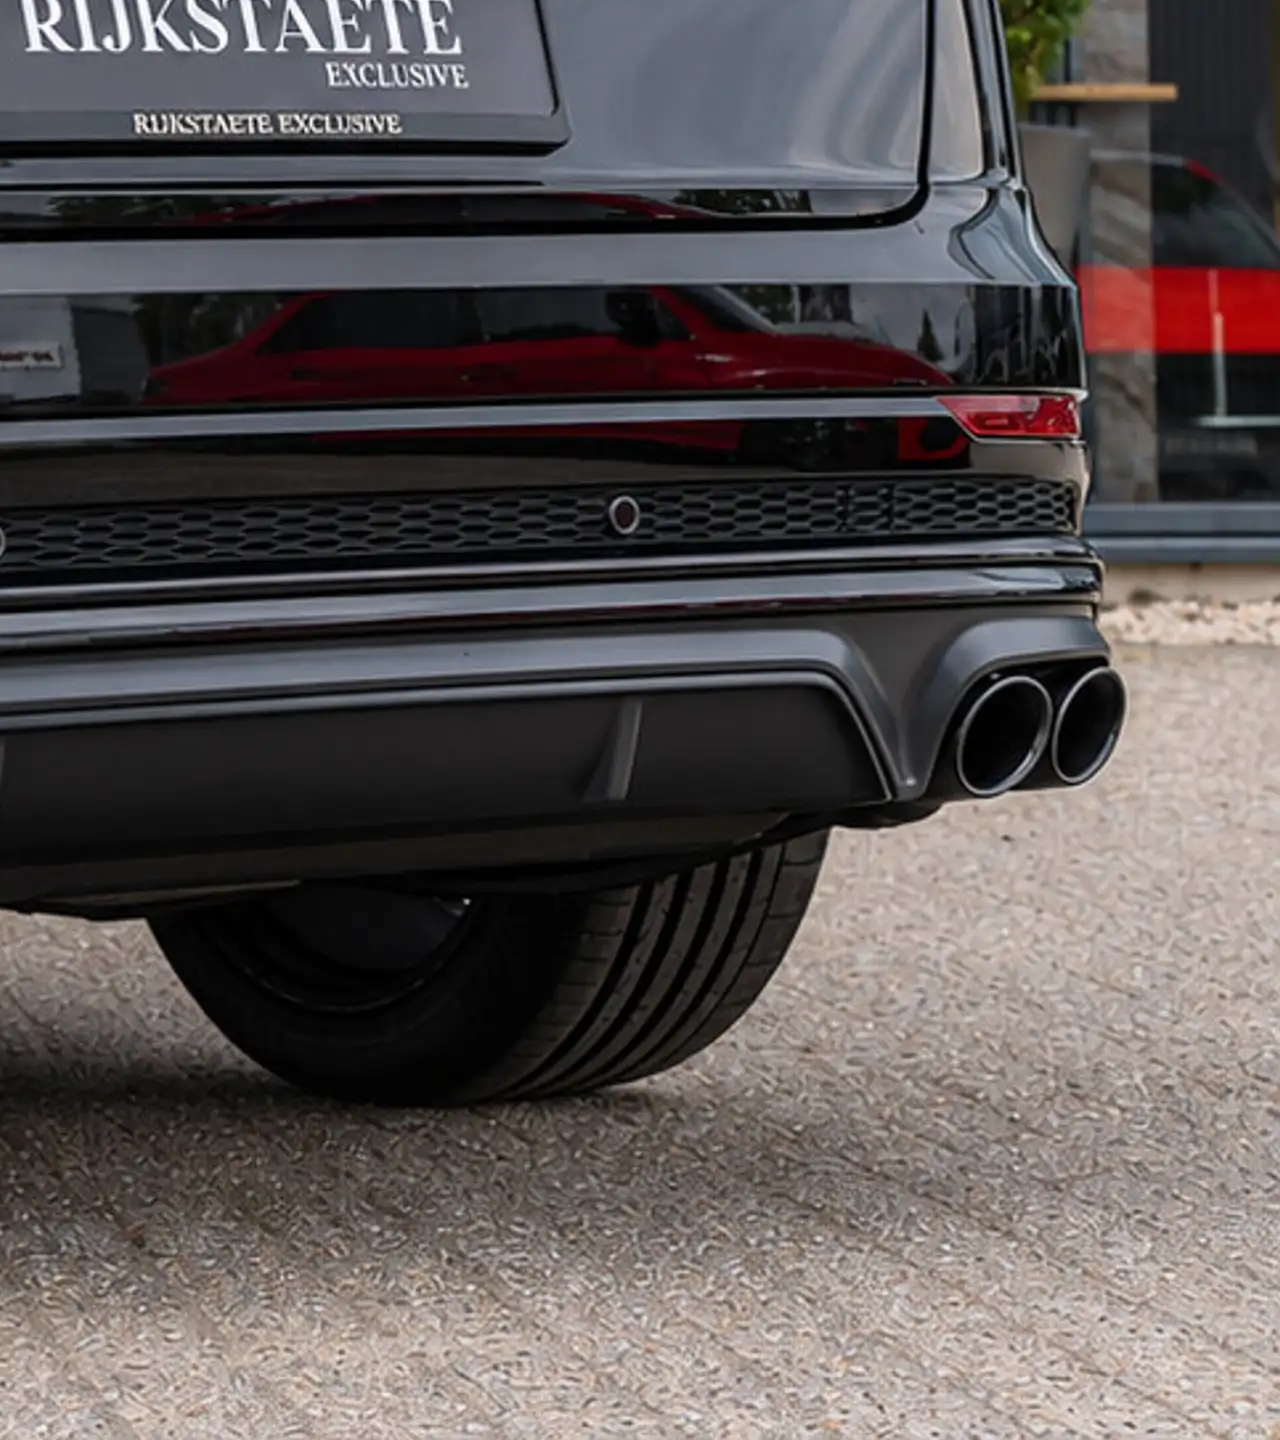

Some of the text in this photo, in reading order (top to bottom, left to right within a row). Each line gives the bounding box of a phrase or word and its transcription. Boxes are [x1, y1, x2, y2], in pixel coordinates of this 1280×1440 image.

[325, 62, 470, 89] EXCLUSIVE
[133, 112, 403, 135] RIJKSTAETE EXCLUSIVE
